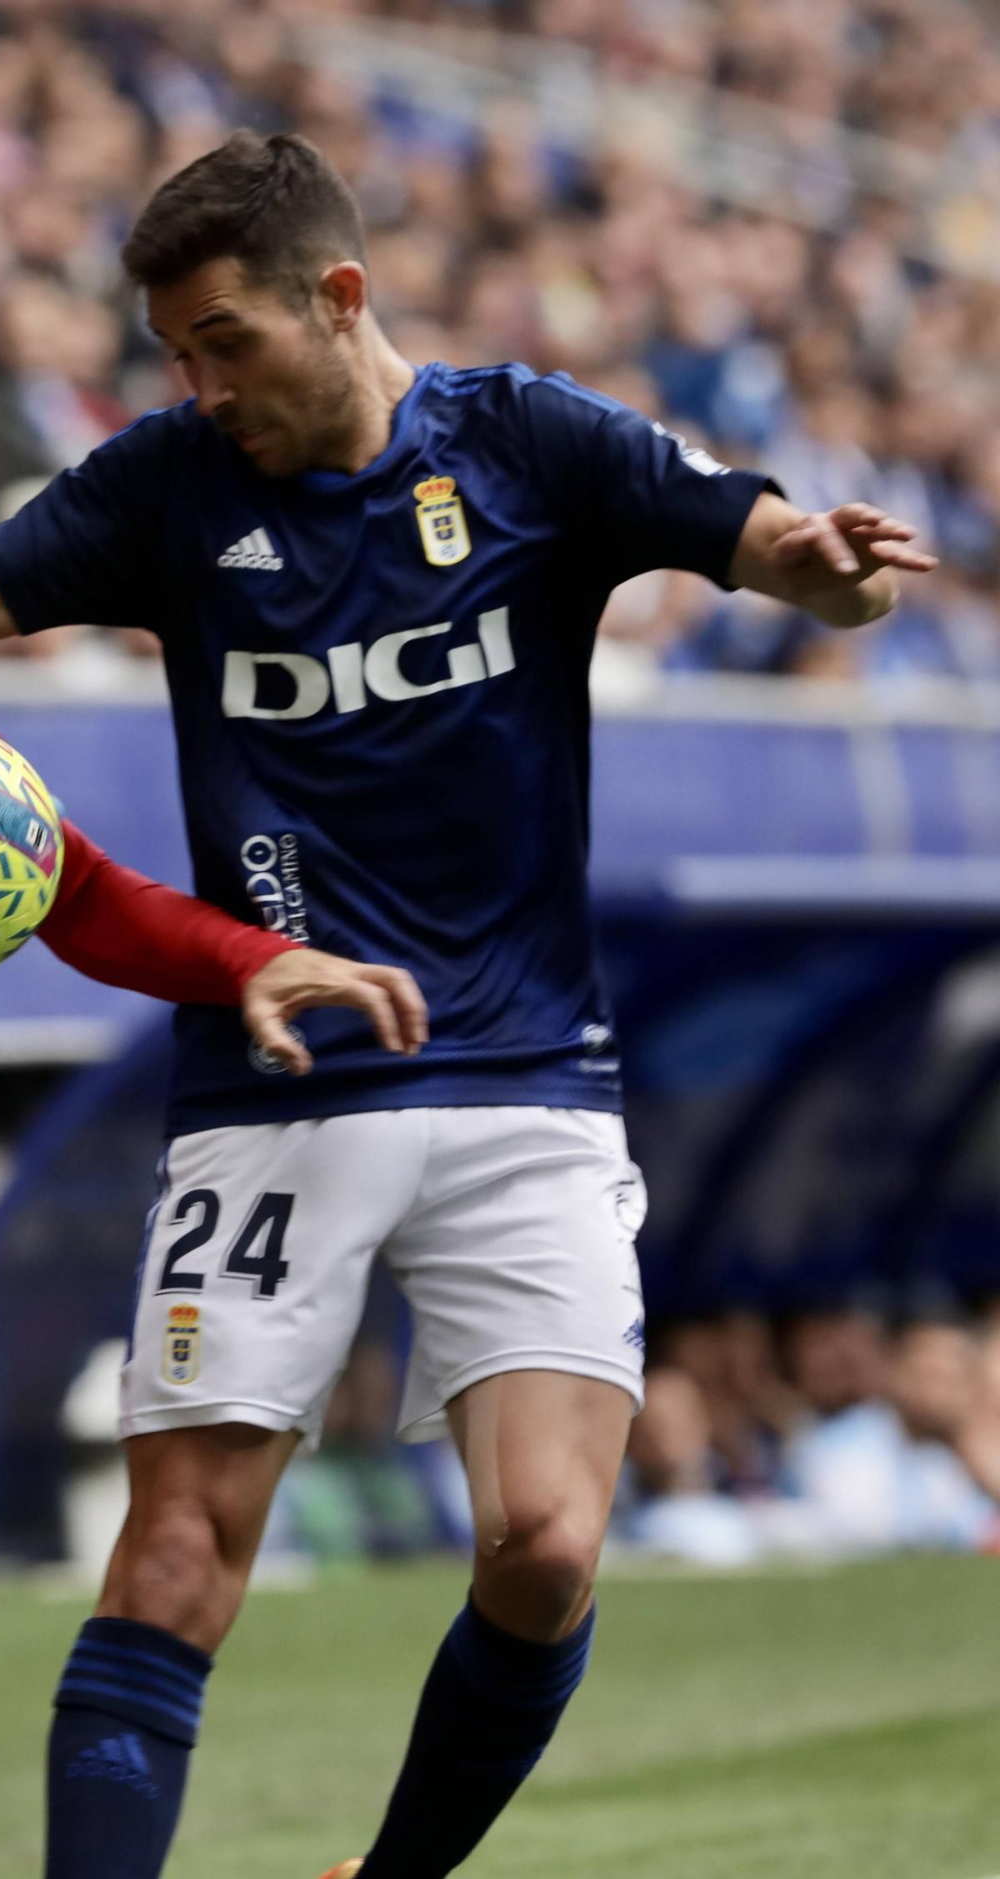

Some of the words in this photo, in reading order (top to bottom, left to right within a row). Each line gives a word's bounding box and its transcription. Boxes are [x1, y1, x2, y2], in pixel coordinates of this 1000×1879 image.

[217, 553, 284, 571] adidas
[221, 606, 516, 720] DIGI
[279, 833, 304, 908] CAMINO
[153, 1188, 297, 1301] 24
